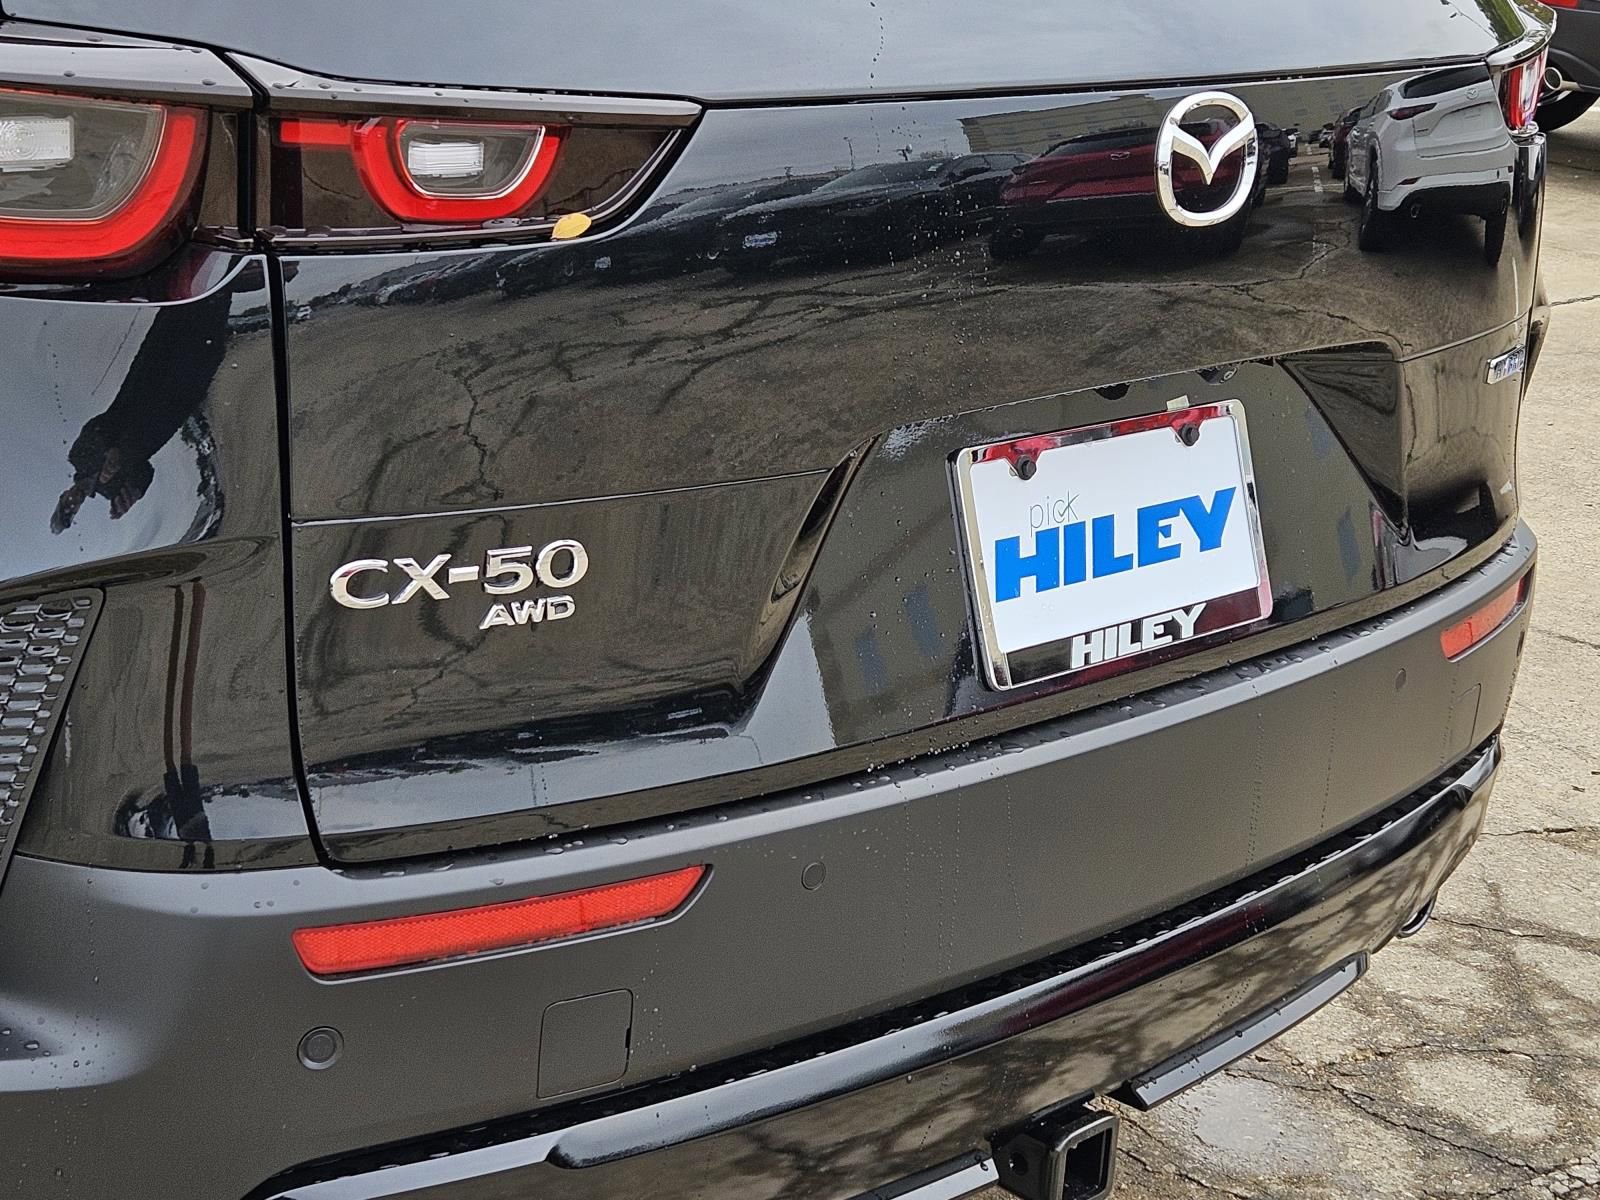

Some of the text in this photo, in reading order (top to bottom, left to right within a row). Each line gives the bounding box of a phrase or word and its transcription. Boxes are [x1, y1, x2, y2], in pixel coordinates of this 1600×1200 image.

[994, 486, 1236, 603] HILEY
[1029, 489, 1080, 537] pick
[330, 539, 589, 609] CX-50
[479, 595, 576, 630] AWD
[1071, 603, 1206, 669] HILEY
